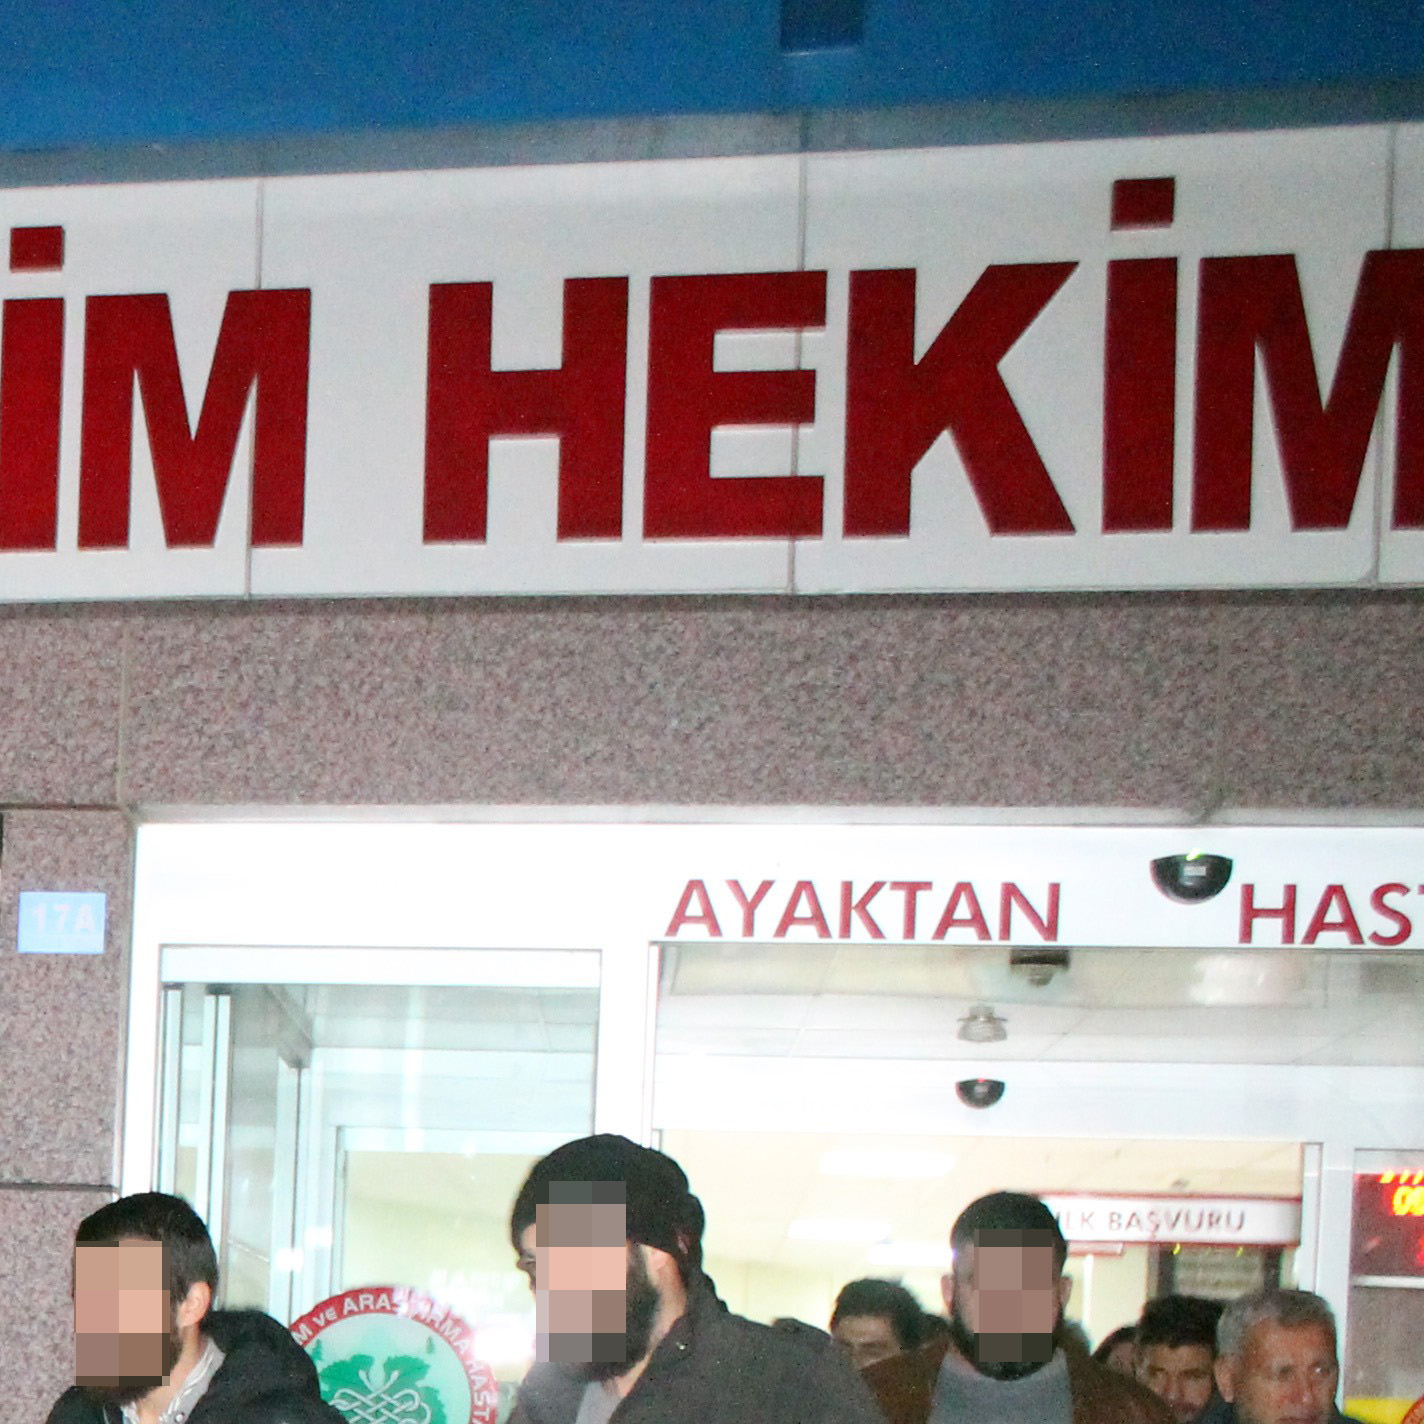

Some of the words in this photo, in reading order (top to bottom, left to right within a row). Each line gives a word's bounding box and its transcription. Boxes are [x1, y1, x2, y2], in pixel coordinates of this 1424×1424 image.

[422, 176, 1424, 544] HEKİM
[664, 879, 1061, 942] AYAKTAN
[1109, 1211, 1246, 1240] BAŞVURU
[313, 1307, 337, 1327] ve
